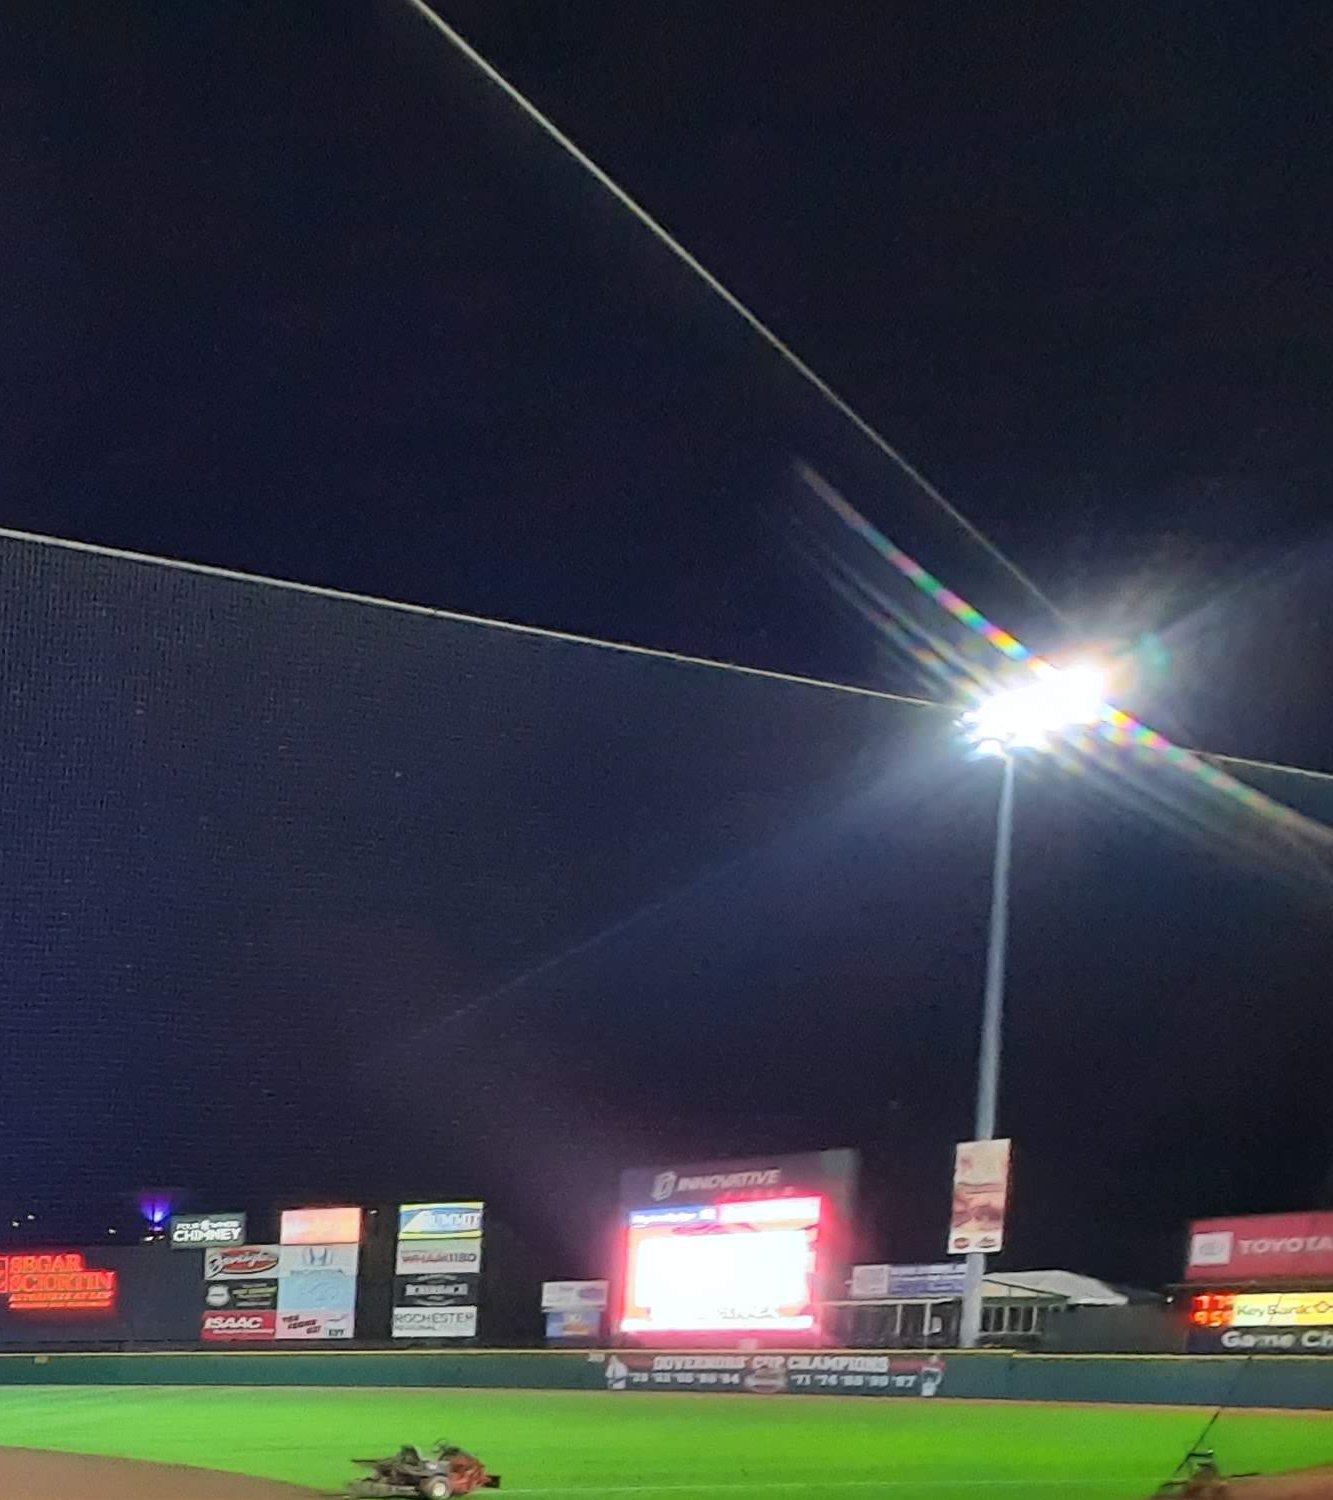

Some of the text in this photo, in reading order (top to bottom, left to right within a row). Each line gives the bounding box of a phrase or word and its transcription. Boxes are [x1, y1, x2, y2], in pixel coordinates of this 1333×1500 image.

[677, 1169, 781, 1192] INNOVATIVE
[173, 1228, 242, 1242] CHIMNEY
[1239, 1236, 1333, 1254] TOYOTA
[10, 1254, 83, 1272] SEGAR
[205, 1316, 264, 1330] ISAAC
[1221, 1330, 1296, 1349] Game
[787, 1356, 890, 1373] CHAMPIONS
